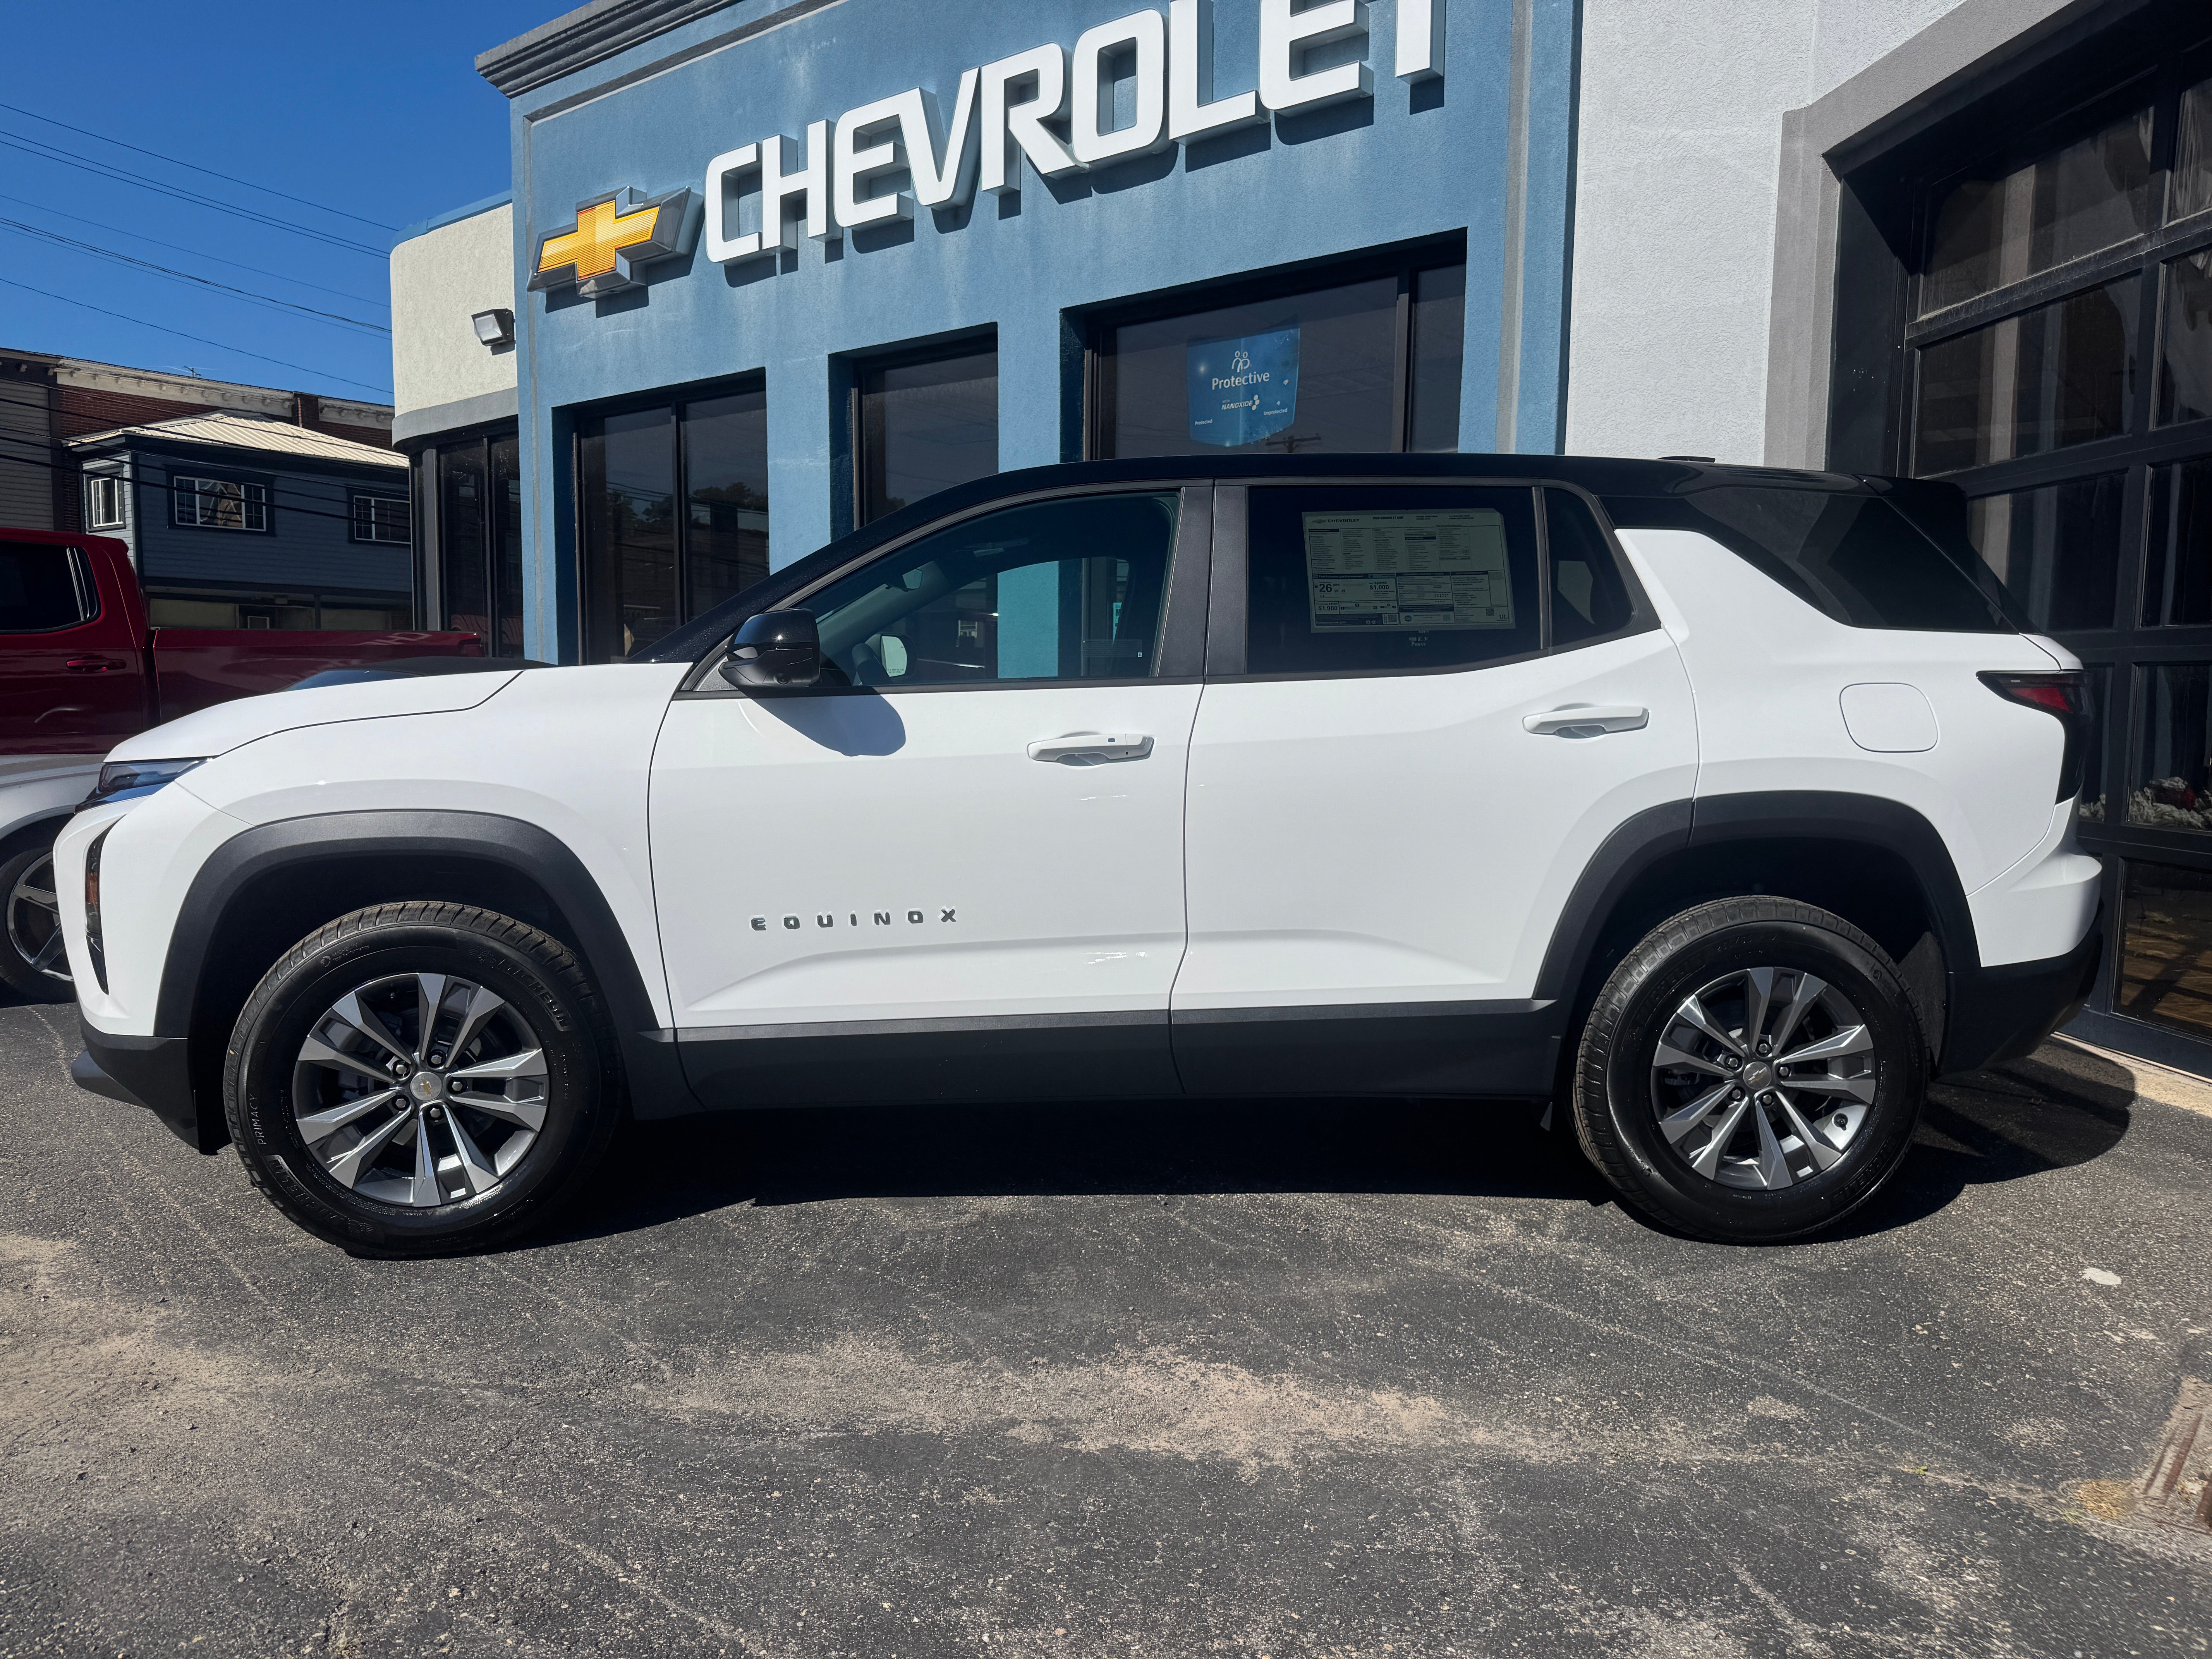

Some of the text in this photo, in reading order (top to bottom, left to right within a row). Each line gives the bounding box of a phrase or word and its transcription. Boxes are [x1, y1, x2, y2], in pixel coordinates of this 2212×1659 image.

[1212, 371, 1270, 390] Protective
[1221, 400, 1253, 410] NANOXIDE
[1319, 584, 1332, 592] 26
[750, 908, 957, 931] EQUINOX
[249, 1093, 267, 1144] PRIMACY
